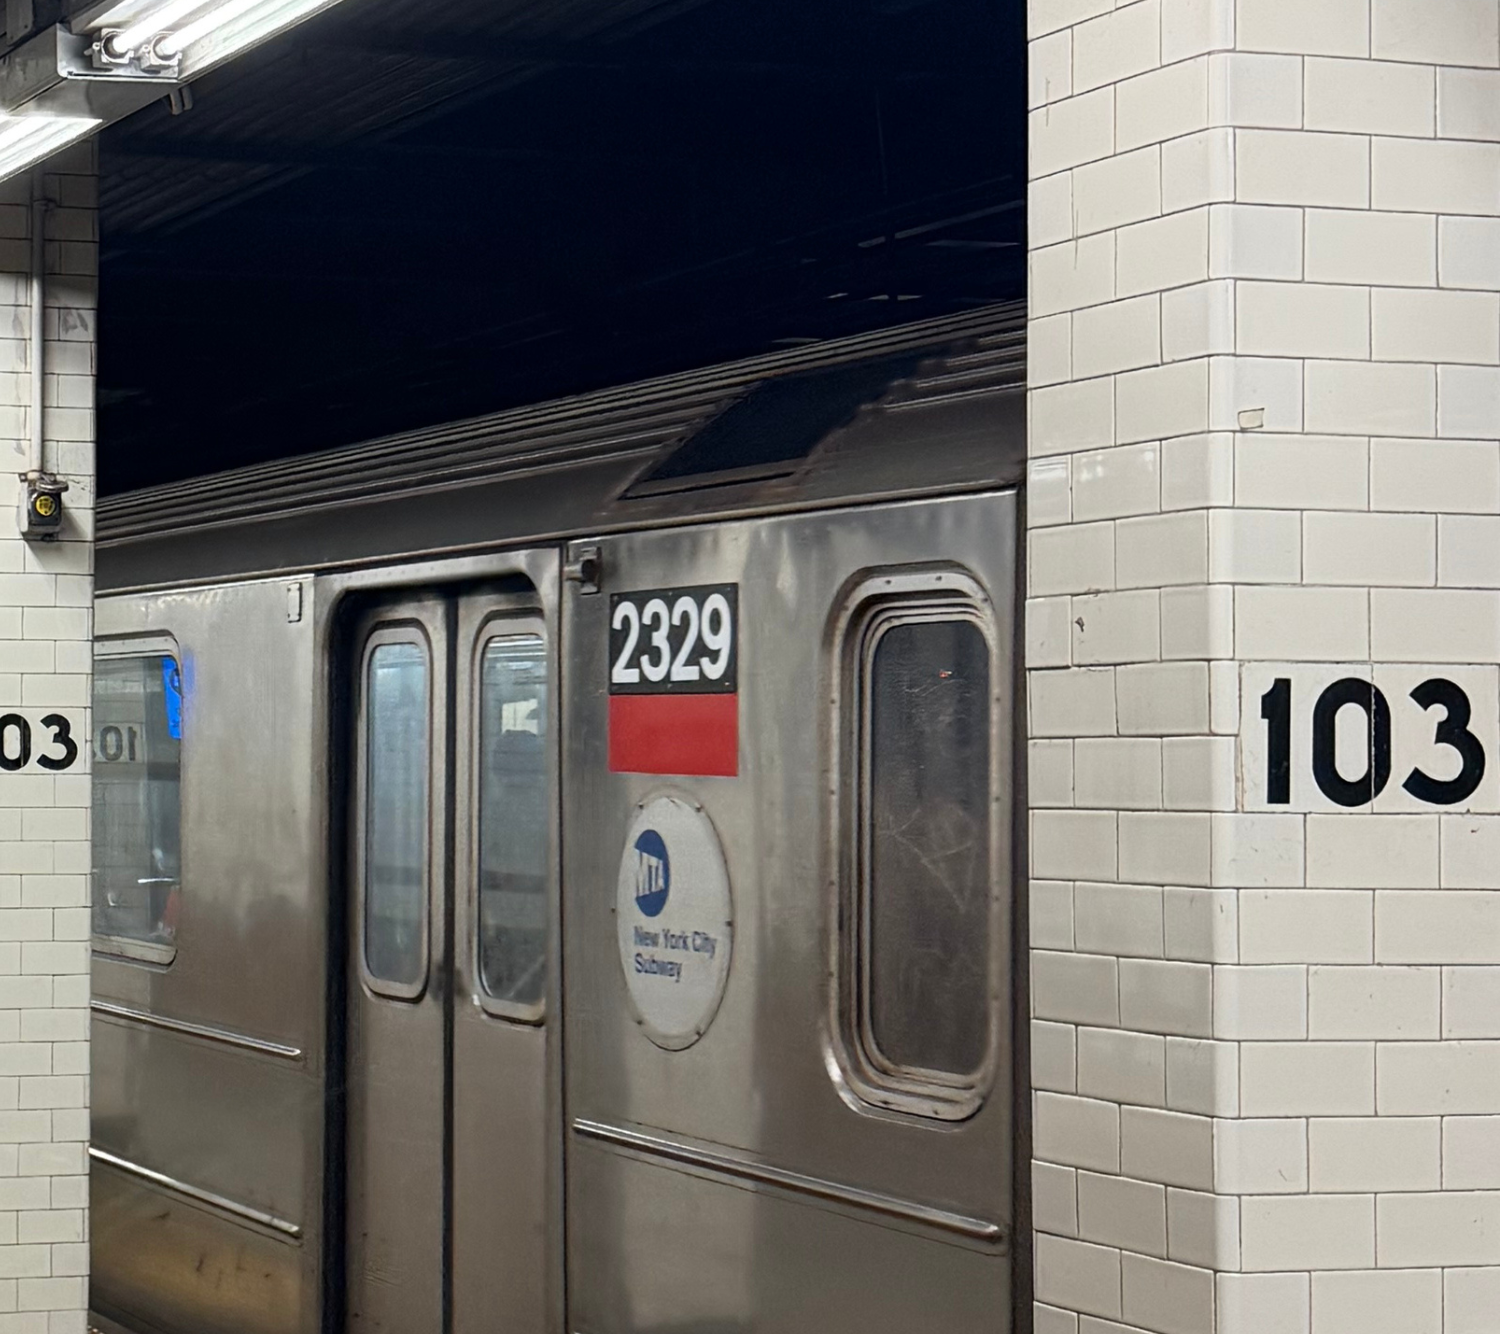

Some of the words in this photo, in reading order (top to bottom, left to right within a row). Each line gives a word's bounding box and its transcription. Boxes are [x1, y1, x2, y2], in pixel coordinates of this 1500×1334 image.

[611, 592, 733, 684] 2329
[1260, 676, 1486, 808] 103
[634, 925, 660, 948] New
[661, 928, 688, 951] York
[691, 931, 717, 960] City
[634, 952, 683, 984] Subway
